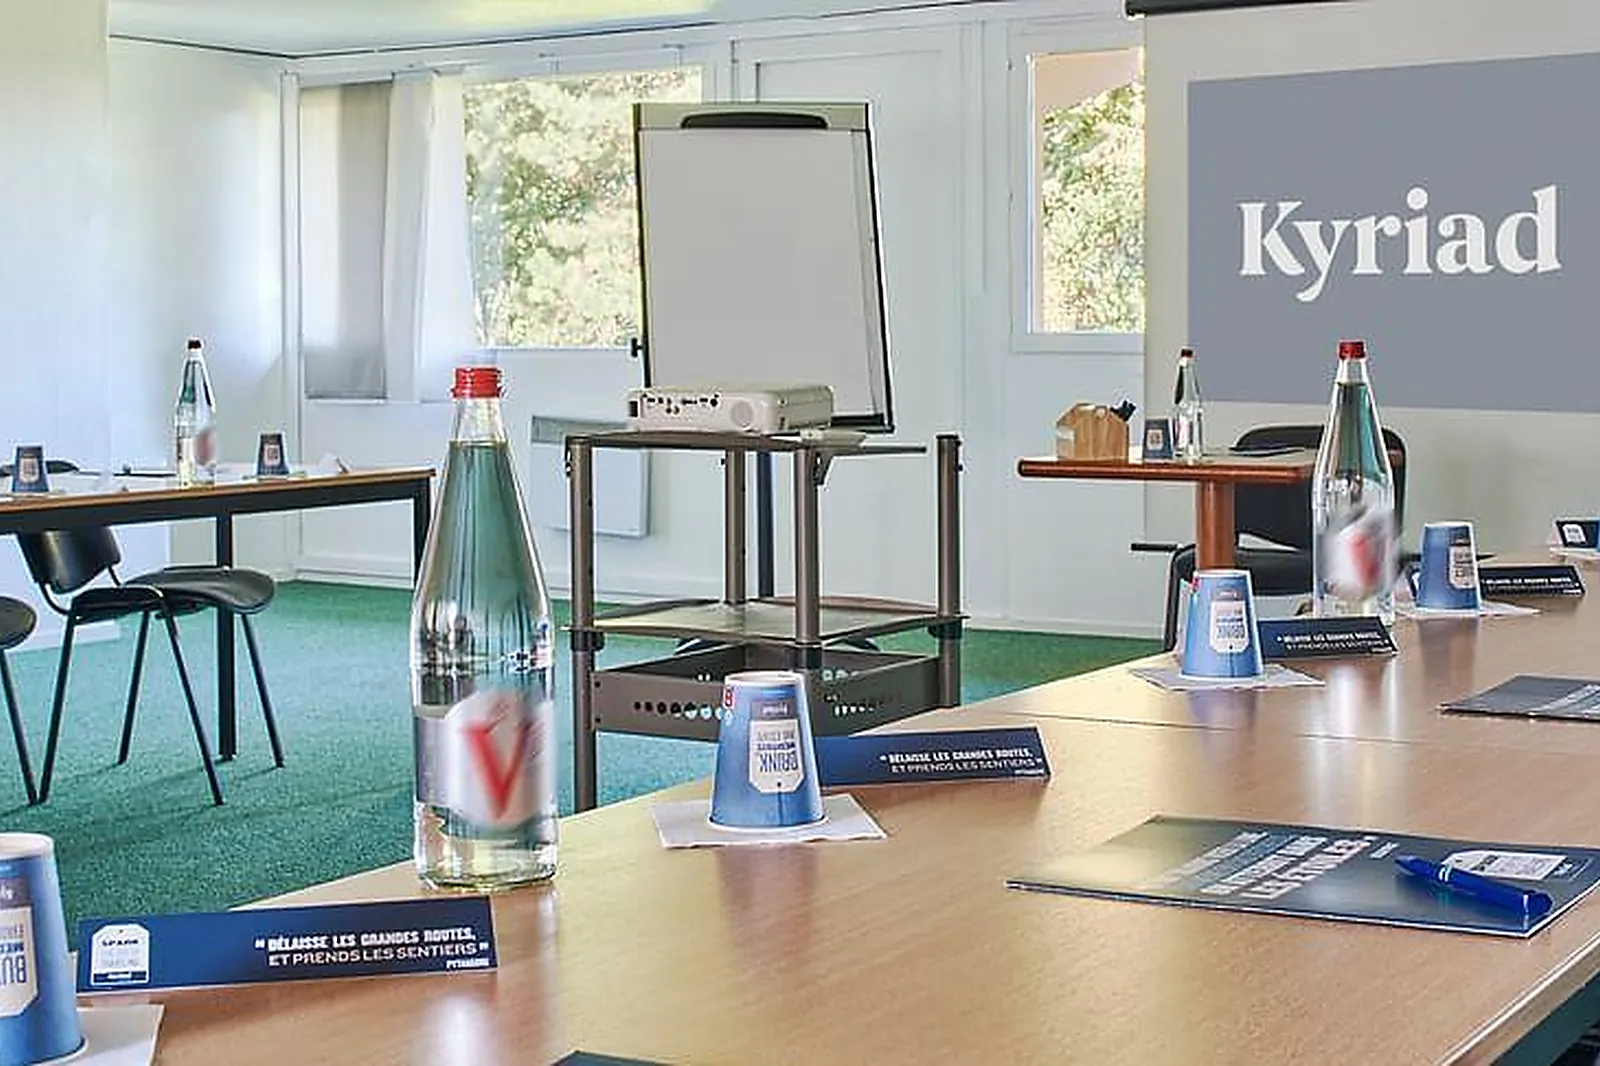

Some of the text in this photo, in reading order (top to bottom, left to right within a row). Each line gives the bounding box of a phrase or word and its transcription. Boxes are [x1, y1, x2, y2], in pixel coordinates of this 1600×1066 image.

[1238, 184, 1562, 302] Kyriad
[332, 933, 356, 949] LES
[360, 930, 419, 947] GRANDES
[268, 954, 290, 967] ET
[292, 949, 361, 965] PRENDS
[363, 947, 394, 961] LES
